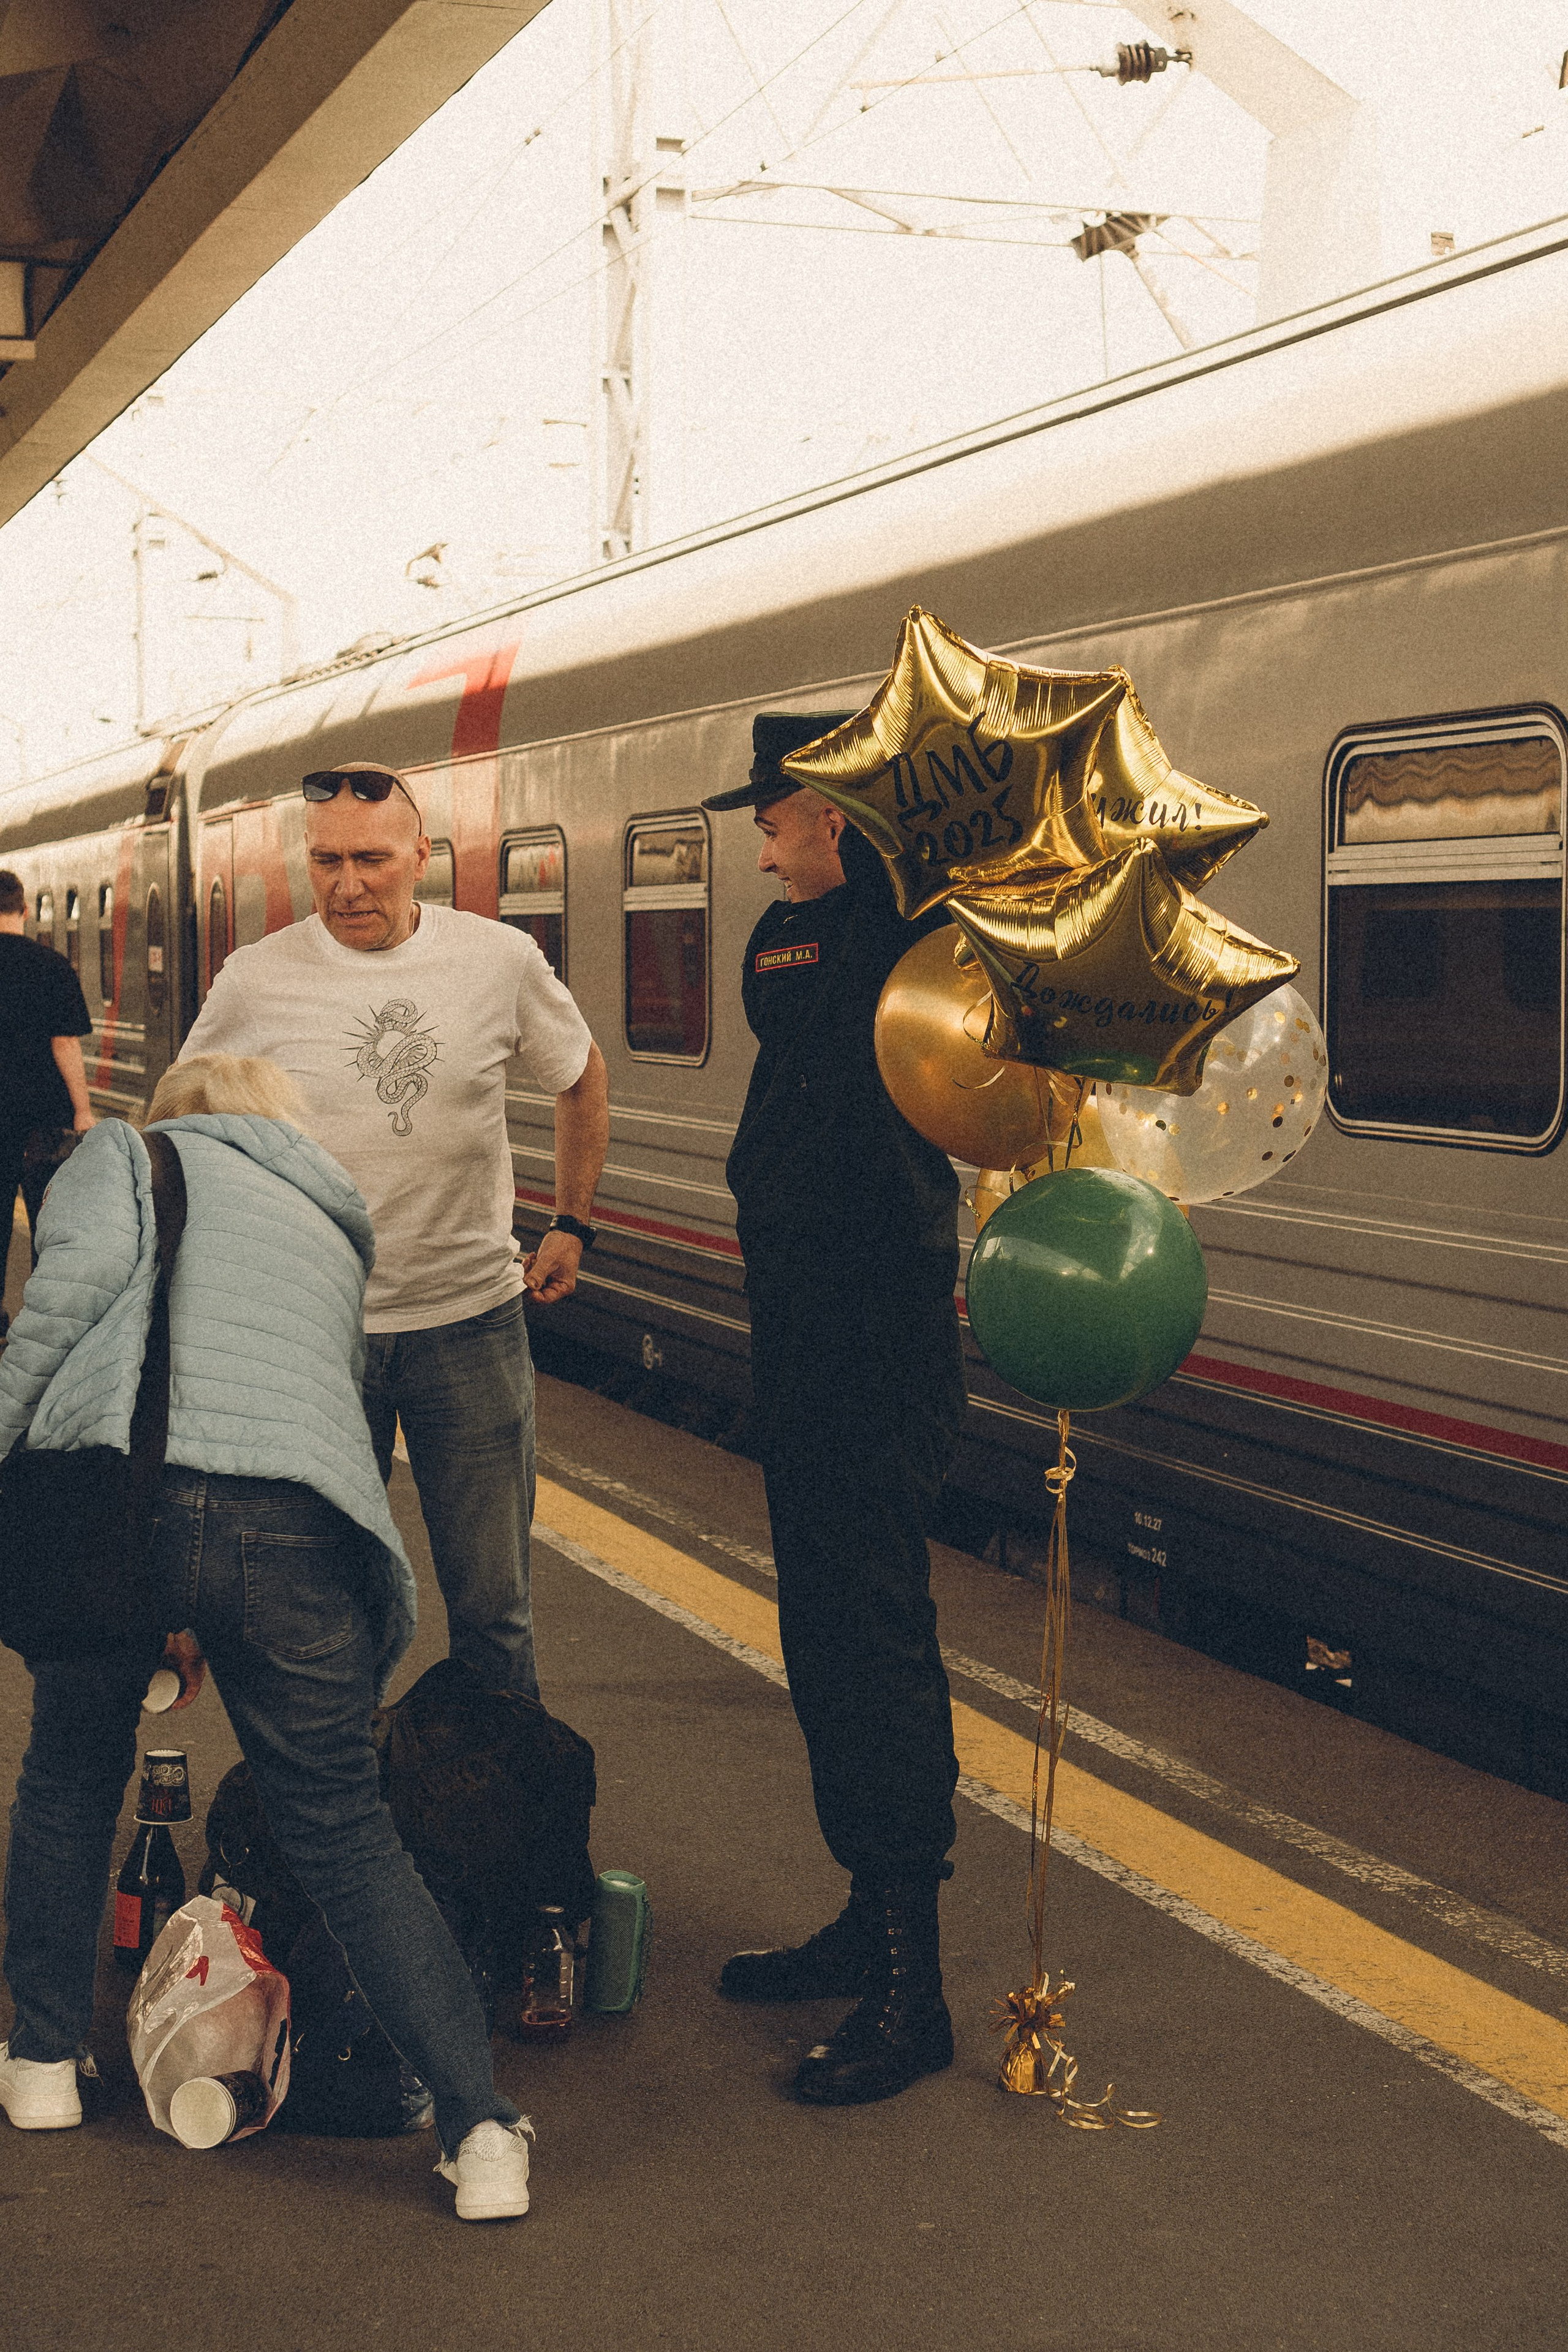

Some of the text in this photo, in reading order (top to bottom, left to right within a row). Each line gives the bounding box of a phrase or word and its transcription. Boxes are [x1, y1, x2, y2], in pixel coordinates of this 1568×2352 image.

[884, 711, 1014, 833] ДМБ
[915, 783, 1023, 867] 2025
[760, 949, 813, 967] ГОНСКИЙ М.А.
[1010, 960, 1234, 1028] Дождались!
[1152, 1547, 1167, 1567] 242
